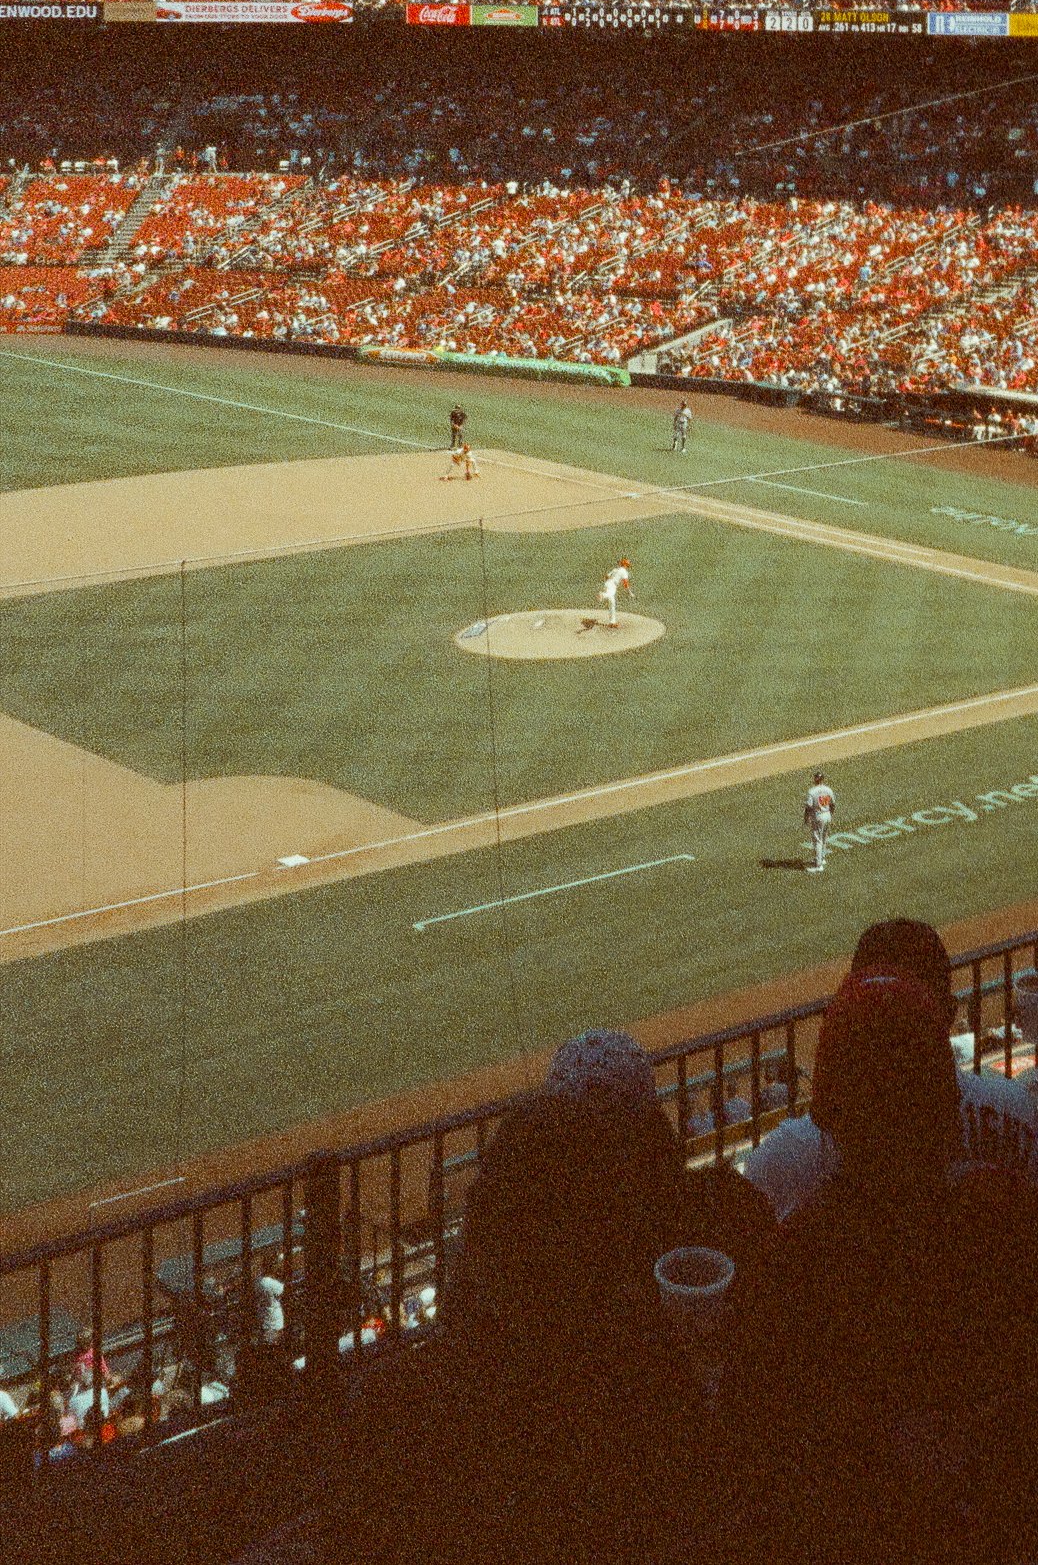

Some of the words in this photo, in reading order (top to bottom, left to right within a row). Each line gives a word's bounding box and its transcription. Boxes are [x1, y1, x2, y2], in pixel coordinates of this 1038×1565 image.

[0, 5, 97, 18] ENWOOD.EDU
[185, 5, 239, 13] DIERBERGS
[242, 5, 288, 13] DELIVERS
[833, 12, 857, 22] MATT
[770, 17, 777, 29] 2
[786, 17, 793, 29] 2
[802, 18, 809, 29] 0
[887, 23, 896, 33] 17
